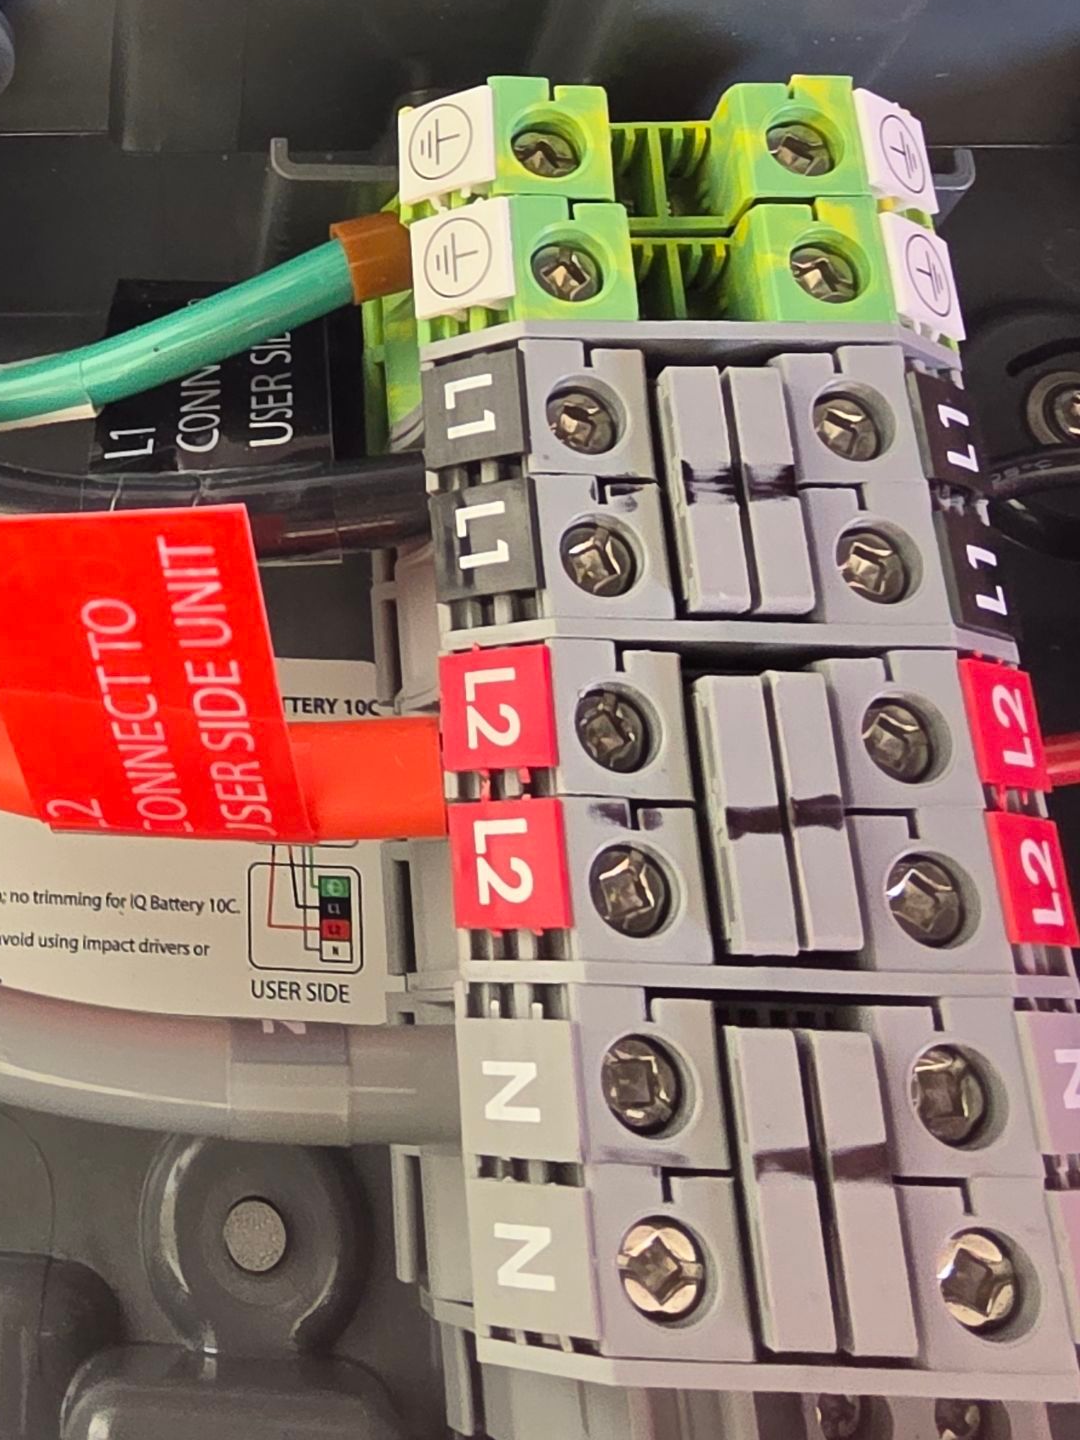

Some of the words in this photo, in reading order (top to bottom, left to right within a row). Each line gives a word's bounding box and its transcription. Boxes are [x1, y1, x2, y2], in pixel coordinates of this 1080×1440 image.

[176, 364, 221, 453] CONN
[249, 373, 294, 448] USER
[444, 372, 496, 439] L1
[939, 403, 980, 473] L1
[104, 427, 157, 460] L1
[455, 500, 510, 569] L1
[156, 535, 233, 648] UNIT
[966, 549, 1008, 617] L1
[80, 598, 143, 661] TO
[184, 660, 256, 753] SIDE
[462, 666, 520, 750] L2
[992, 682, 1036, 770] L2
[46, 798, 110, 829] 2
[474, 818, 534, 906] L2
[1022, 837, 1067, 928] L2
[10, 891, 28, 903] no
[33, 891, 101, 910] trimming
[105, 892, 126, 909] for
[130, 894, 147, 911] IQ
[151, 895, 205, 916] Battery
[38, 934, 78, 953] using
[82, 935, 136, 956] impact
[139, 937, 190, 956] drivers
[194, 944, 211, 956] or
[251, 979, 301, 1001] USER
[306, 982, 350, 1004] SIDE
[481, 1061, 541, 1124] N
[493, 1222, 556, 1292] N
